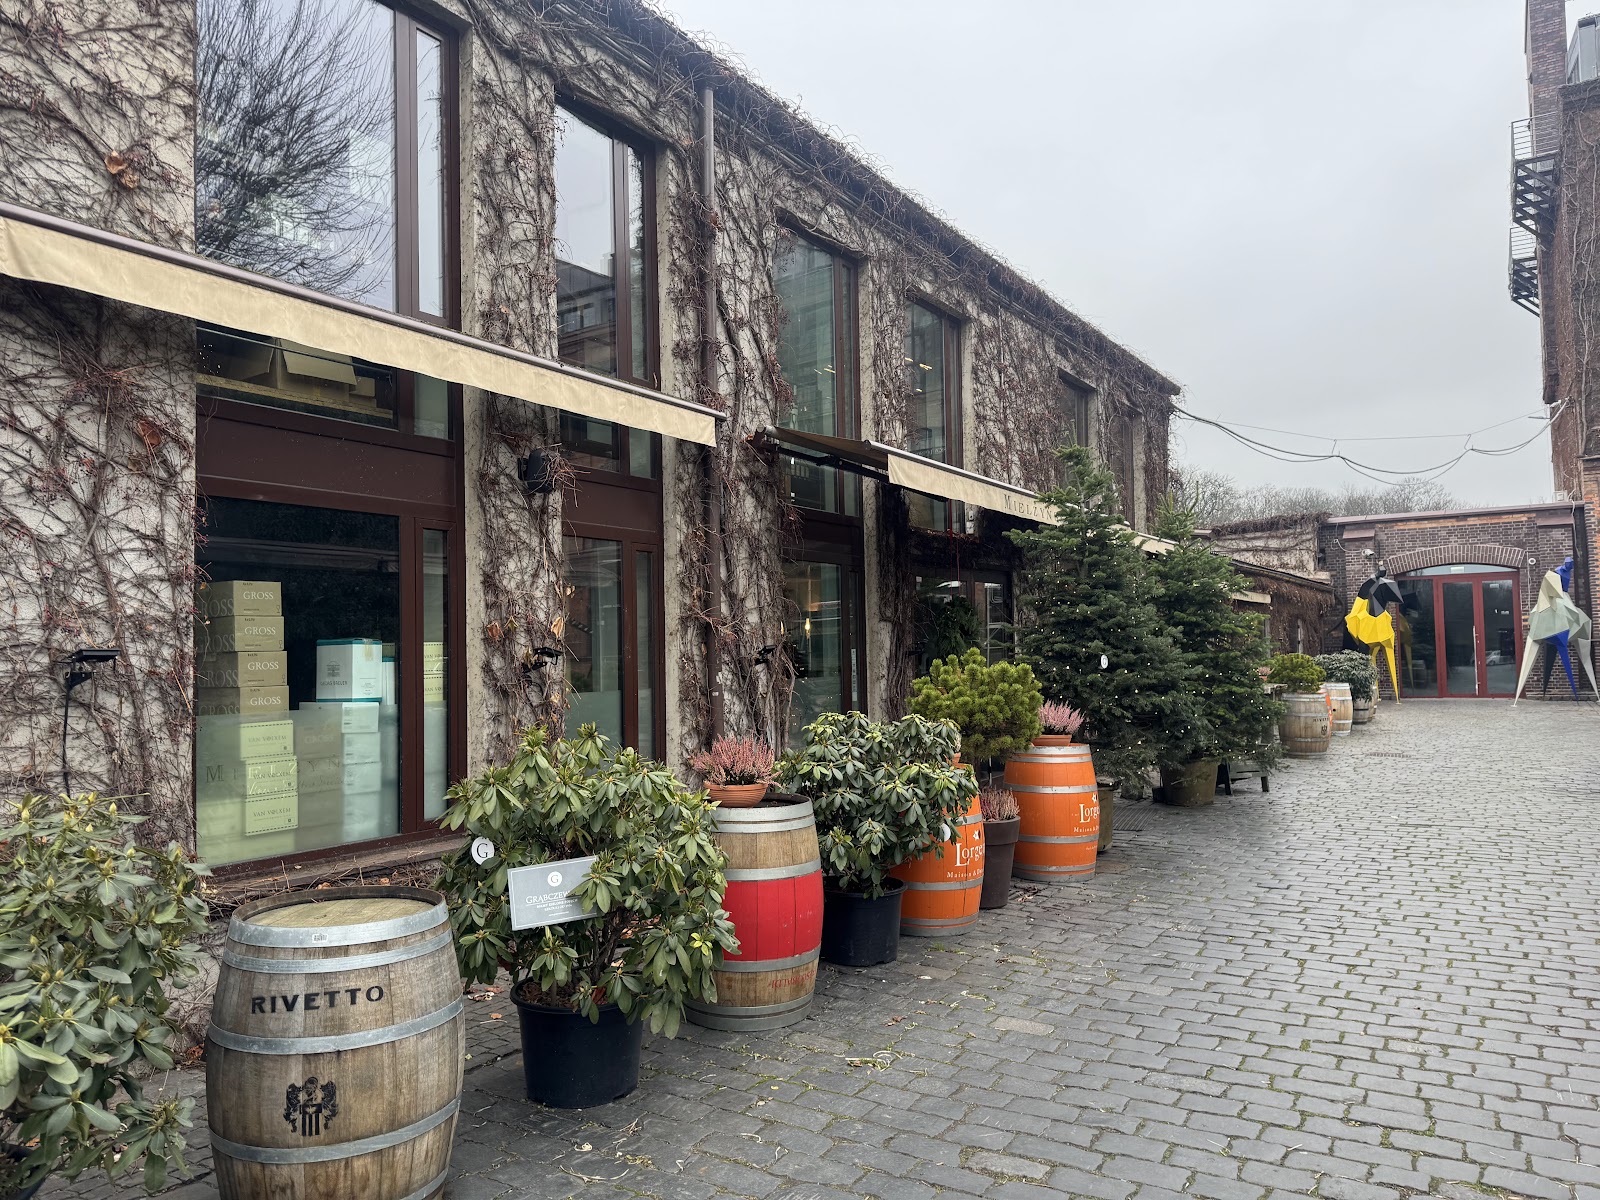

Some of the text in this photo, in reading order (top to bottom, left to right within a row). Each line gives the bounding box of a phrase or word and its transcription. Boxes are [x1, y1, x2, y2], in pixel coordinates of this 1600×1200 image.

[243, 591, 274, 600] GROSS
[201, 598, 234, 617] ROSS
[244, 626, 276, 635] GROSS
[247, 661, 279, 671] GROSS
[250, 696, 281, 706] GROSS
[476, 842, 488, 859] G
[550, 874, 559, 884] G
[251, 985, 384, 1014] RIVETTO
